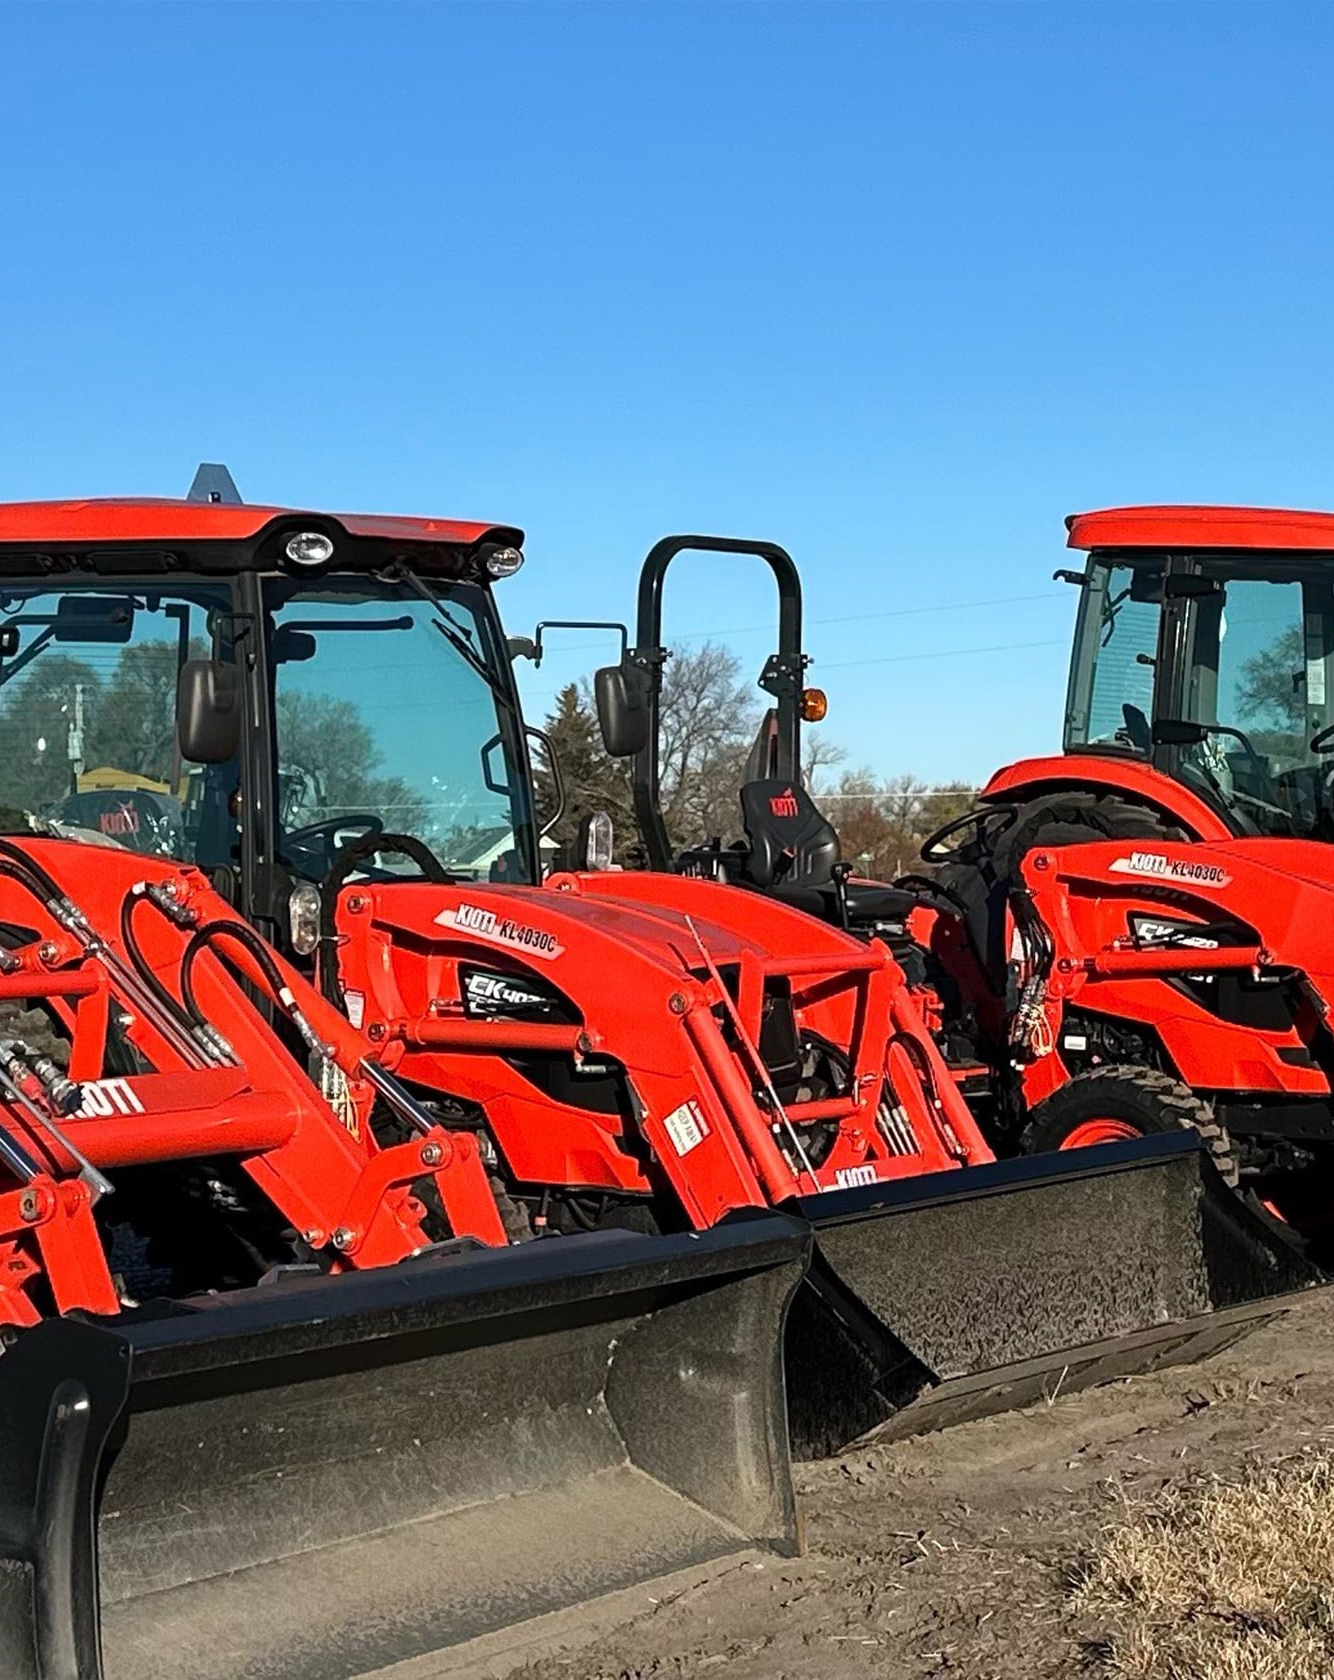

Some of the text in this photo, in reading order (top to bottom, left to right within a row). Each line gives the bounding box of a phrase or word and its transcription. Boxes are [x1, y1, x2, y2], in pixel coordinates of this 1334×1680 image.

[1130, 850, 1225, 883] KIOTI KL4030C
[455, 902, 557, 953] KIOTI KL4030C
